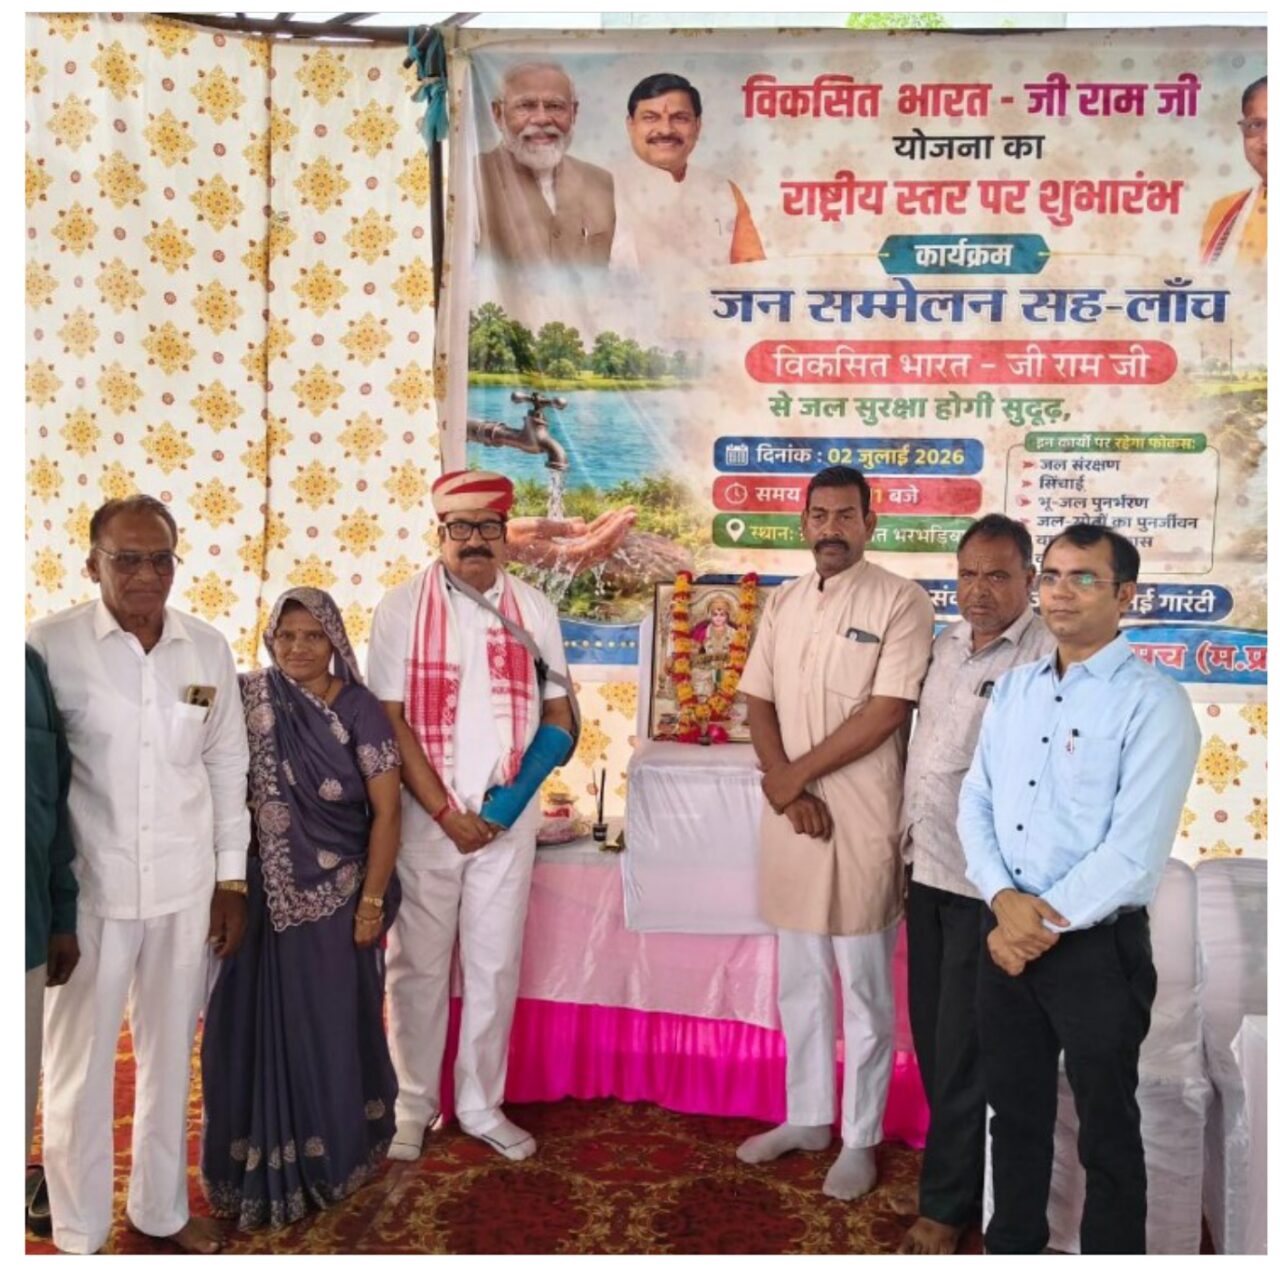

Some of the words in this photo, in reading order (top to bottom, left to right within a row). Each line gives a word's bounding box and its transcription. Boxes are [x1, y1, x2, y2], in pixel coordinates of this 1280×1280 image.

[742, 73, 883, 120] विकसित
[897, 82, 992, 119] भारत
[1023, 72, 1071, 118] जी
[1076, 83, 1148, 118] राम
[1154, 72, 1201, 118] जी
[893, 127, 995, 161] योजना
[1002, 135, 1045, 161] का
[780, 170, 887, 223] राष्ट्रीय
[894, 180, 971, 215] स्तर
[977, 180, 1030, 215] पर
[1038, 171, 1184, 227] शुभारंभ
[914, 241, 1014, 267] कार्यक्रम
[711, 288, 794, 323] जन
[807, 276, 1007, 323] सम्मेलन
[772, 343, 891, 378] विकसित
[899, 353, 971, 378] भारत
[1006, 343, 1047, 378] जी
[1053, 353, 1104, 378] राम
[1111, 343, 1150, 378] जी
[768, 391, 794, 418] से
[798, 397, 846, 418] जल
[854, 397, 927, 425] सुरक्षा
[934, 390, 995, 420] होगी
[757, 443, 812, 464] दिनांक
[827, 448, 852, 464] 02
[857, 444, 910, 469] जुलाई
[915, 448, 965, 465] 2026
[1036, 437, 1053, 449] इन
[1094, 437, 1111, 449] पर
[1040, 459, 1068, 471] जल
[1071, 457, 1120, 472] संरक्षण
[755, 487, 800, 503] समय
[888, 484, 919, 504] बजे
[1039, 476, 1084, 493] सिंचाई
[1158, 589, 1216, 613] गारंटी
